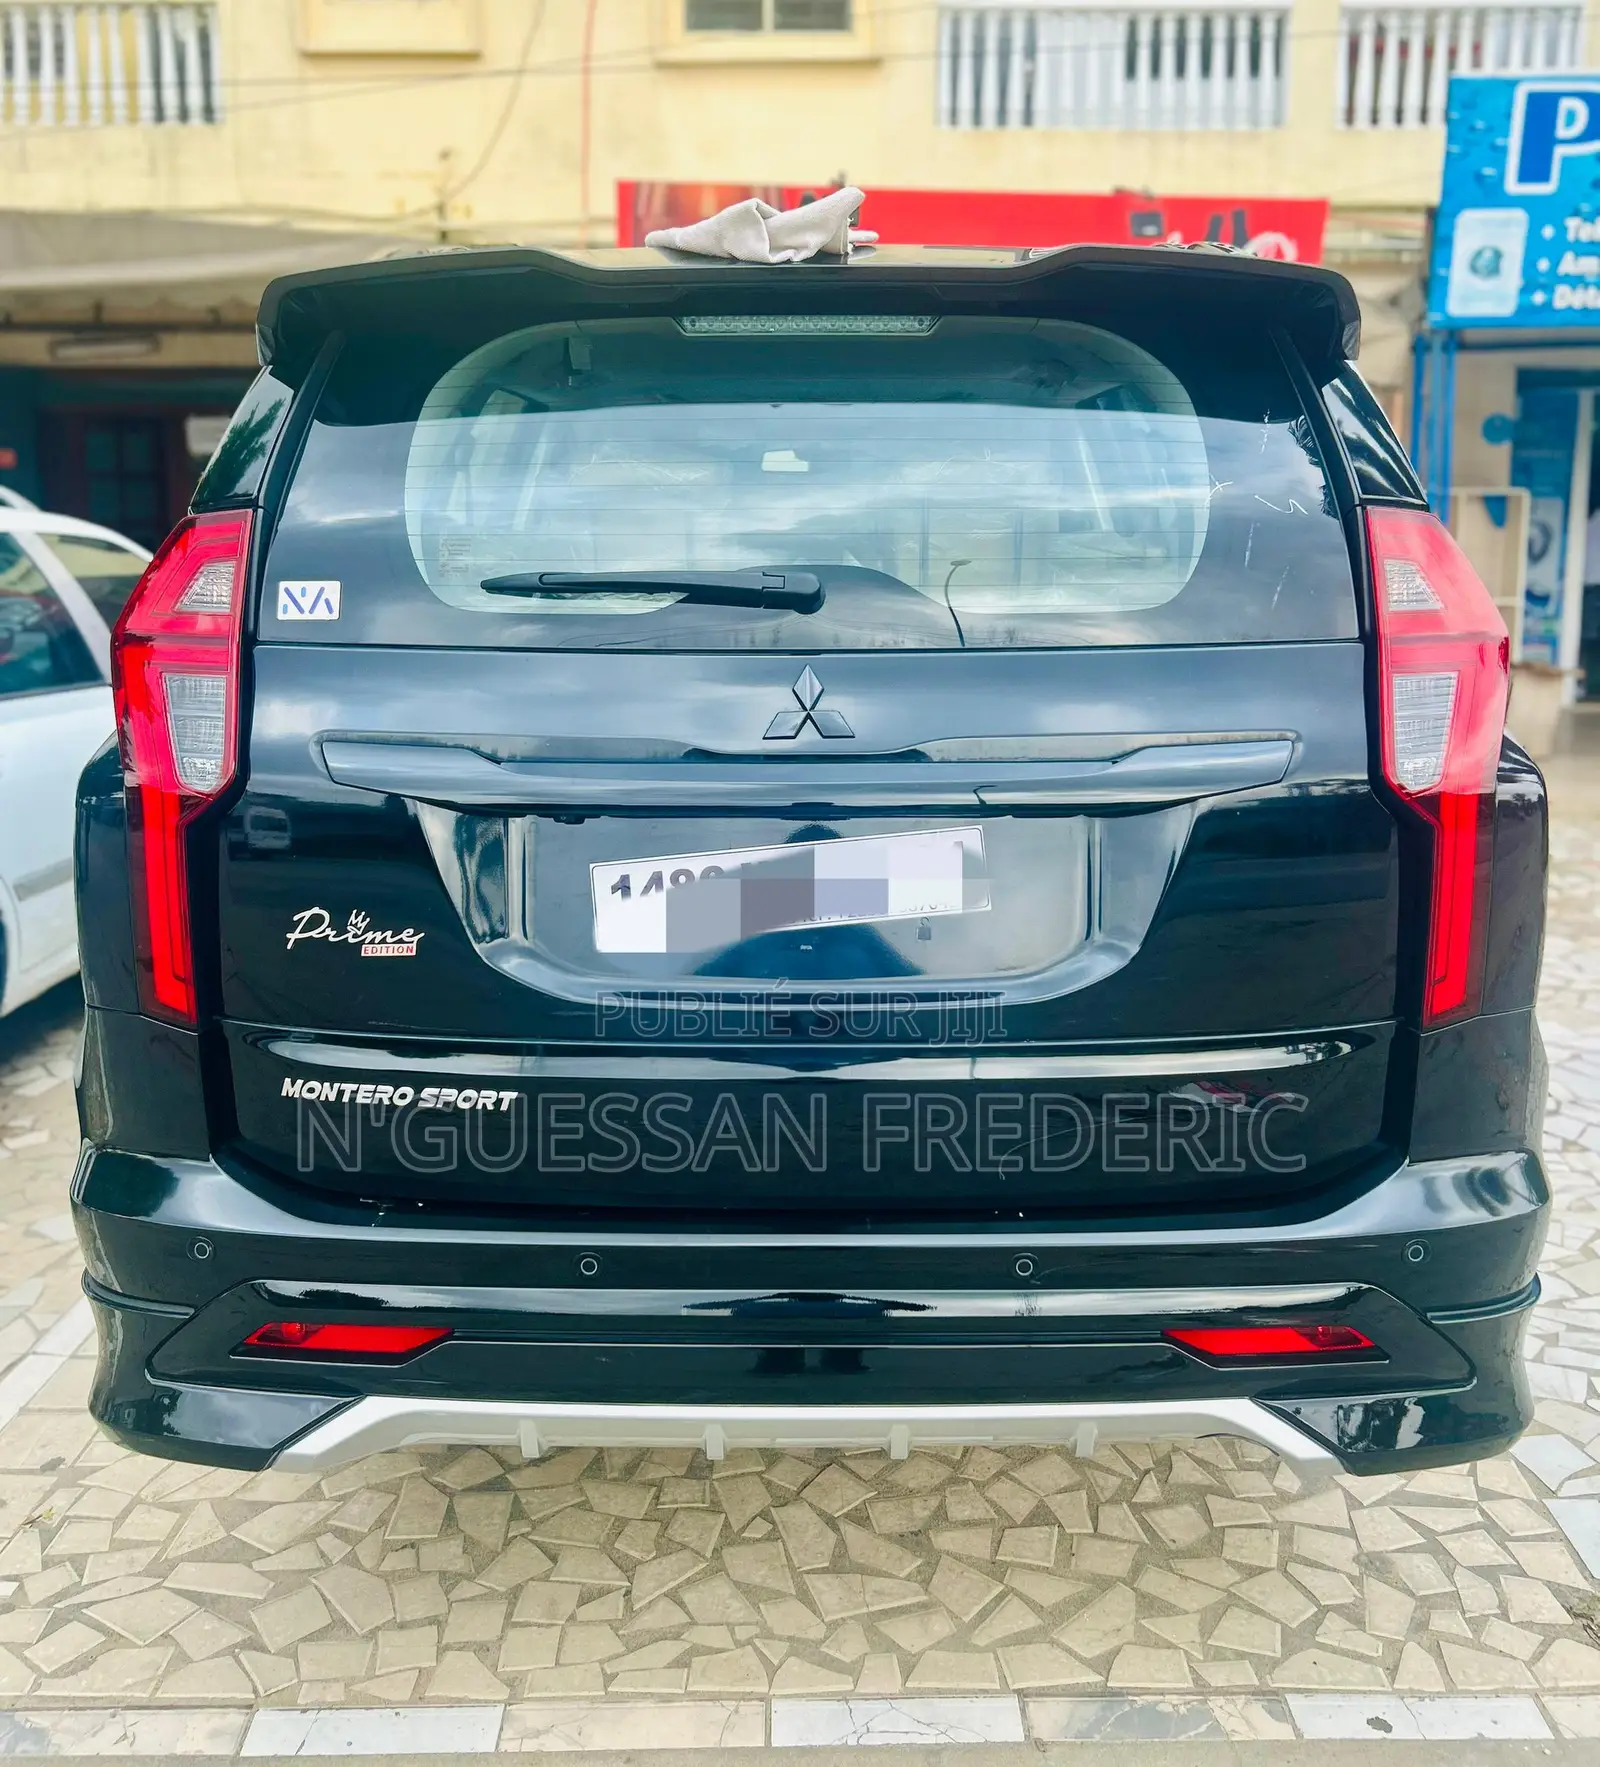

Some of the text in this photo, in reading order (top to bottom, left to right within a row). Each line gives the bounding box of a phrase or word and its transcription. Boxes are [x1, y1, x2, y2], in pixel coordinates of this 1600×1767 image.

[286, 906, 425, 949] Prime
[363, 945, 414, 955] EDITION
[281, 1077, 519, 1112] MONTERO SPORT
